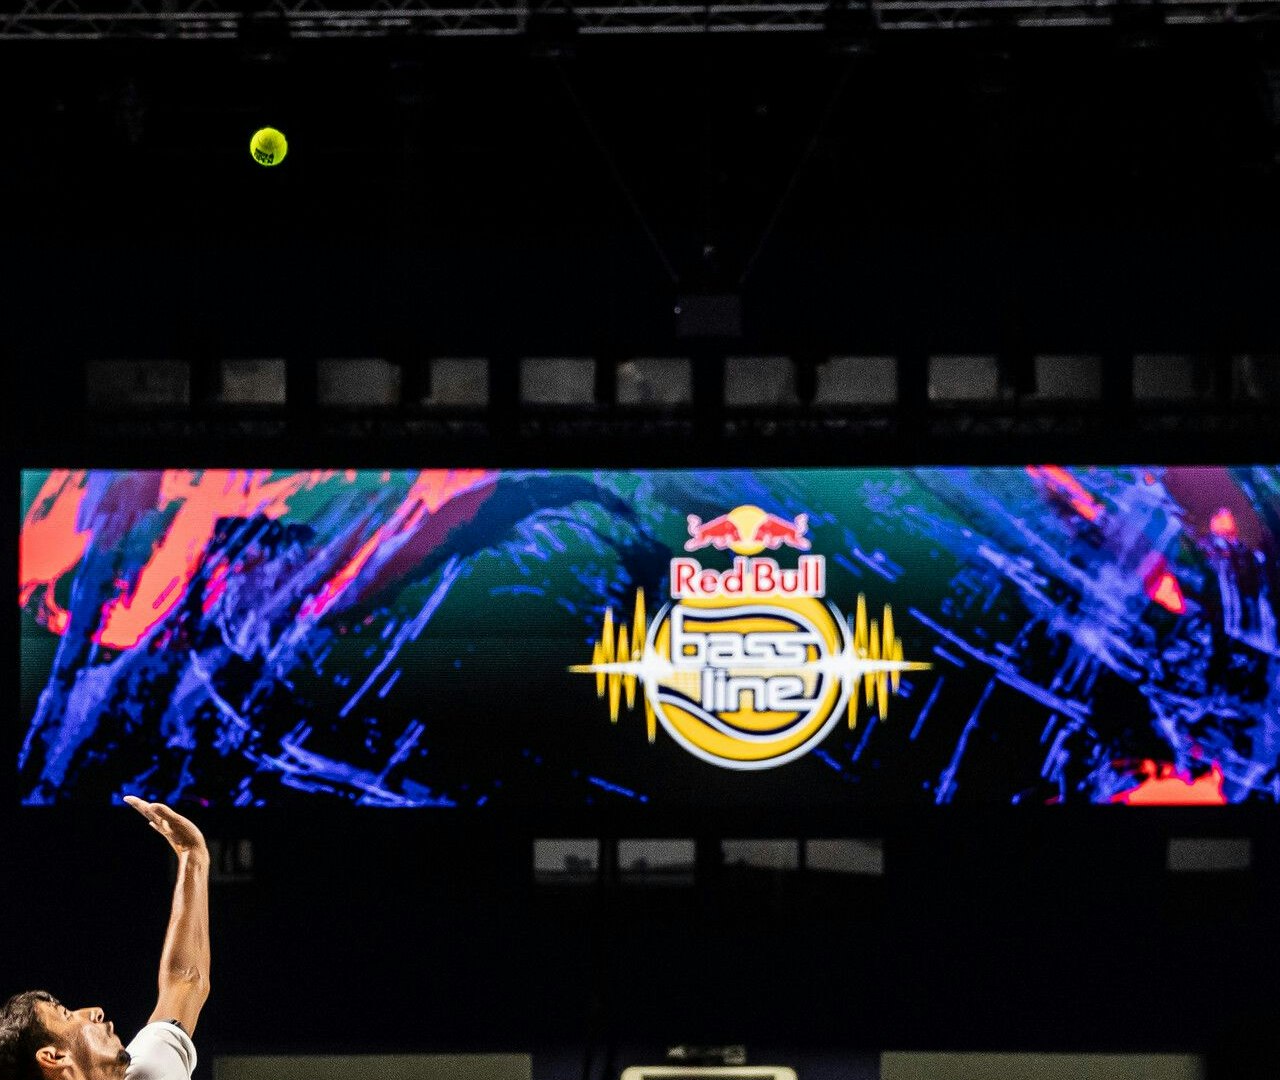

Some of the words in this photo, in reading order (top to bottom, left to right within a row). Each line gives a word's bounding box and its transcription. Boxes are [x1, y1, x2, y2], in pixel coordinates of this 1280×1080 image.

[673, 558, 747, 596] Red
[751, 556, 823, 596] Bull
[671, 604, 819, 669] bass
[701, 666, 814, 714] line
